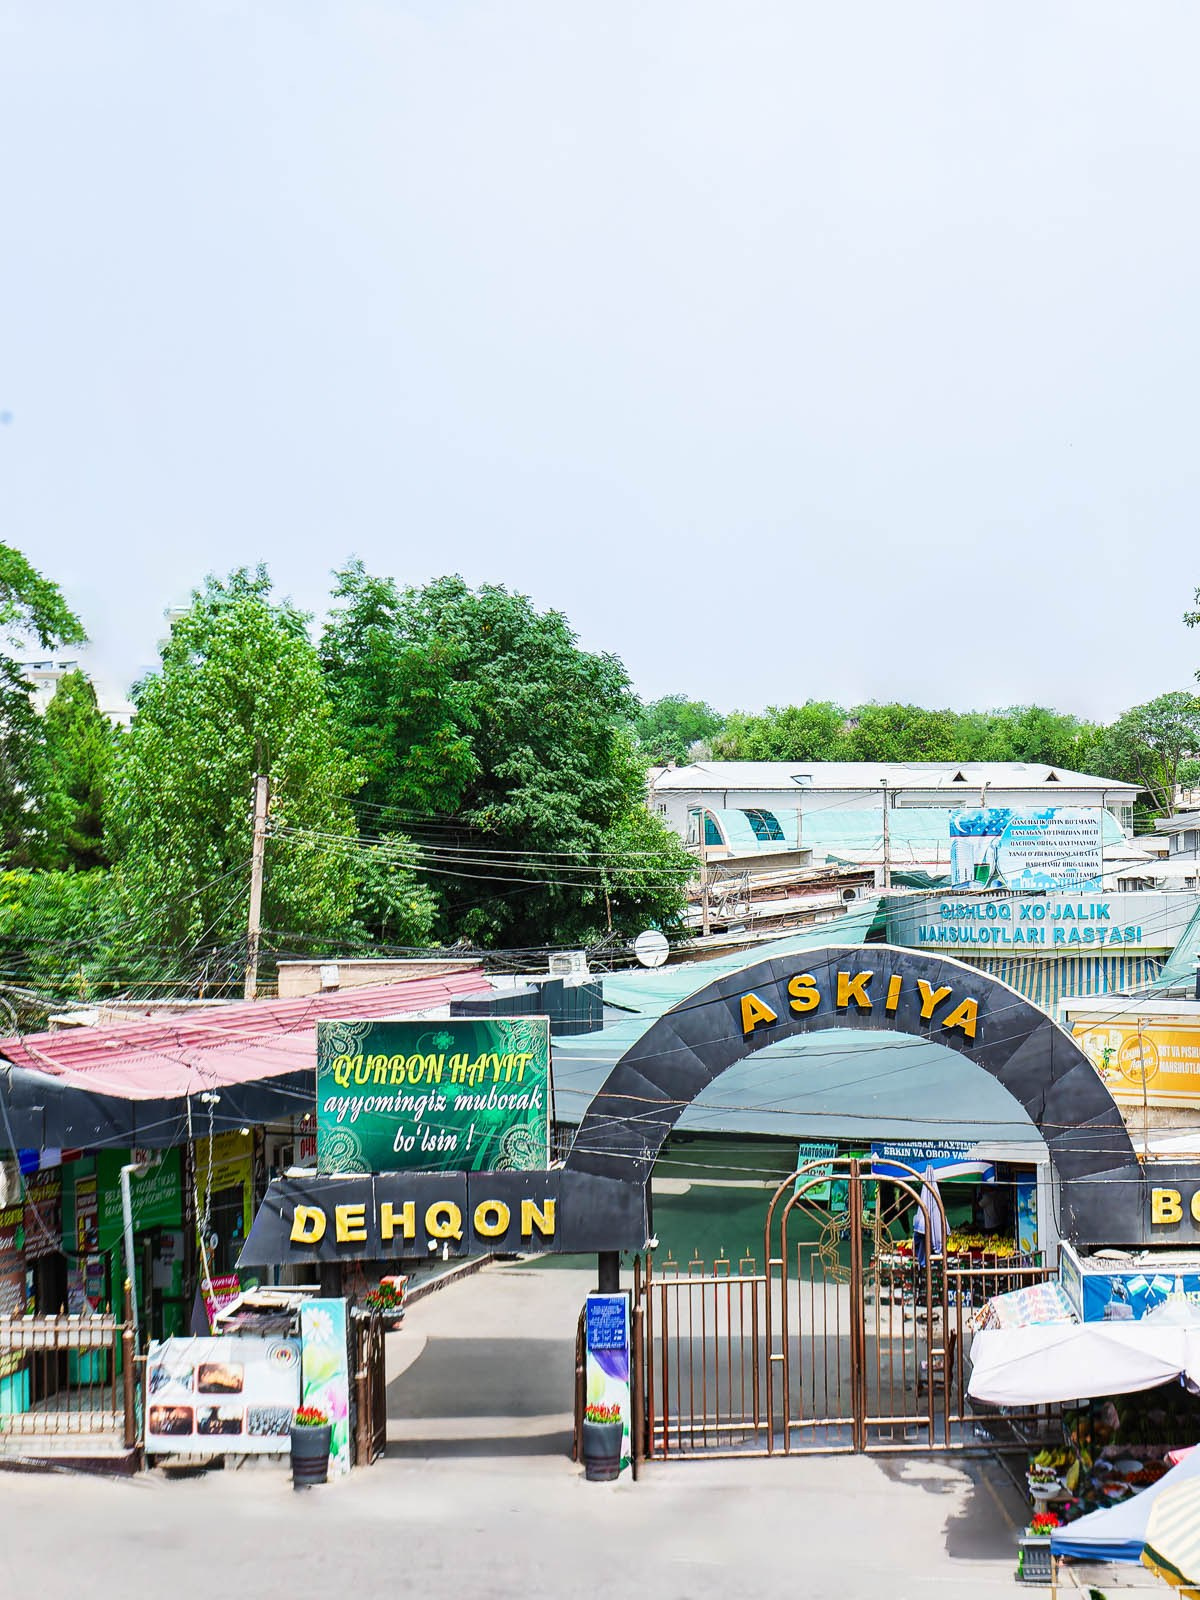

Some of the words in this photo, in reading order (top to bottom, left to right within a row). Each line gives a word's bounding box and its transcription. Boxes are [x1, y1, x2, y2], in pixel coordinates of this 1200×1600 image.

[939, 902, 1011, 921] QISHLOQ
[1019, 901, 1111, 921] XO'JALIK
[918, 925, 1045, 944] MAHSULOTLARI
[1053, 925, 1142, 943] RASTASI
[740, 970, 979, 1038] ASKIYA
[332, 1052, 446, 1088] QURBON
[447, 1052, 534, 1087] HAYIT
[323, 1088, 447, 1124] ayyomingiz
[453, 1084, 543, 1112] muborak
[883, 1146, 912, 1157] ERKIN
[912, 1148, 925, 1158] VA
[925, 1149, 951, 1160] OBOD
[290, 1198, 557, 1244] DEHQON
